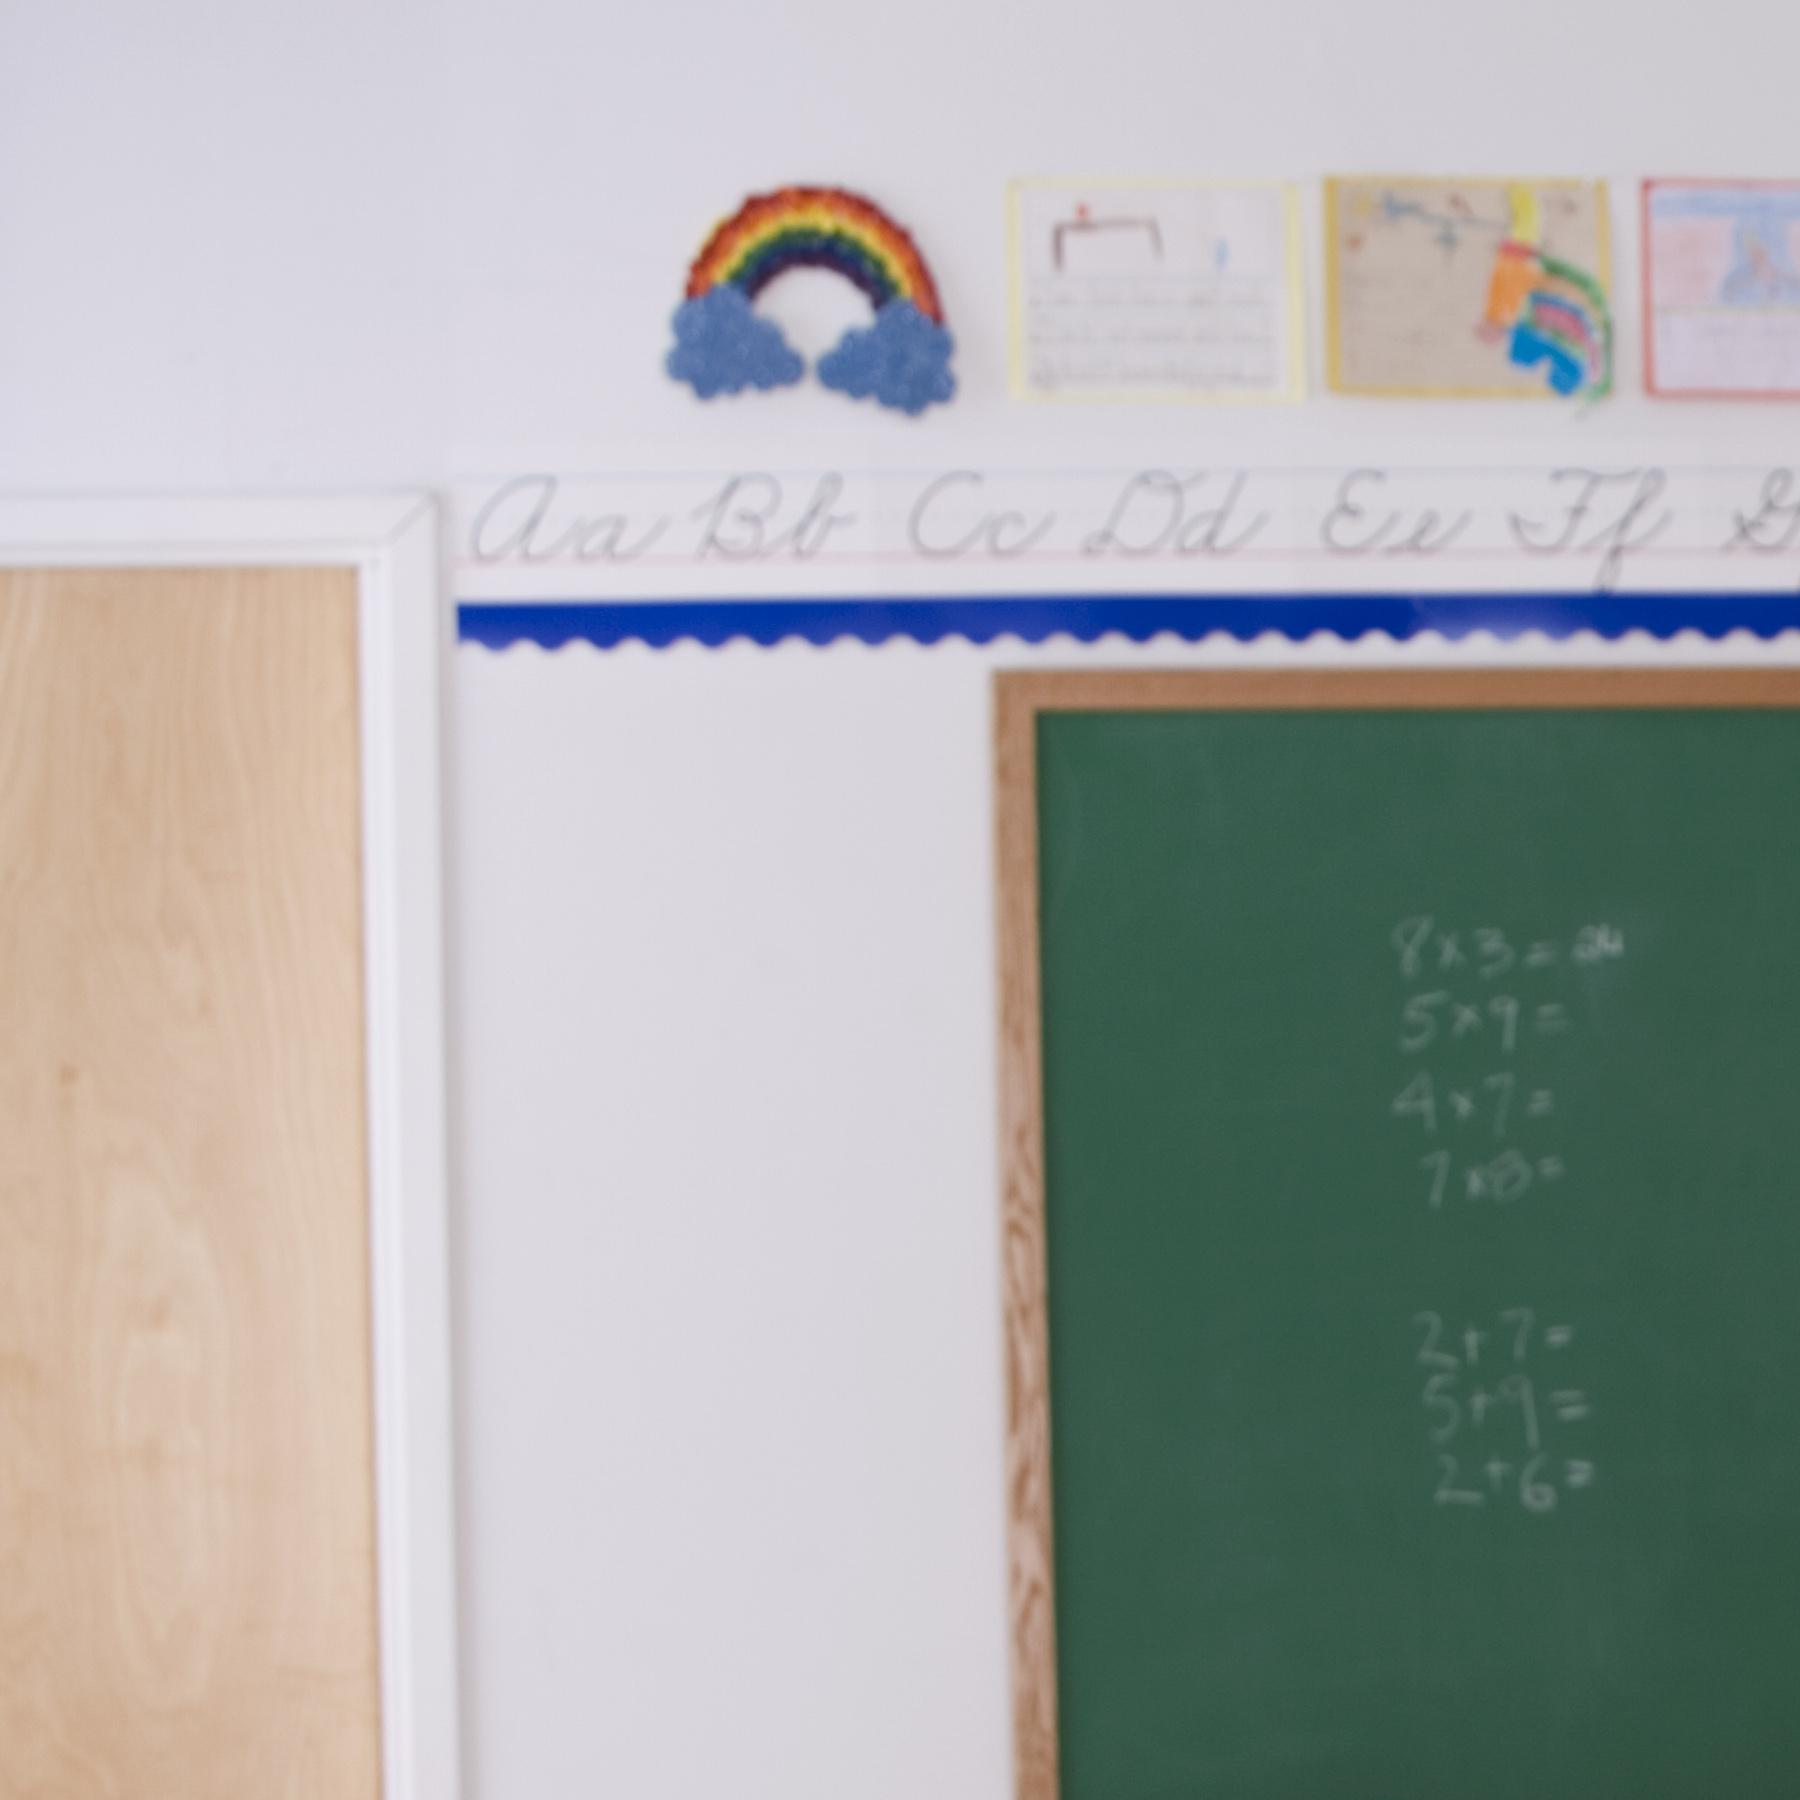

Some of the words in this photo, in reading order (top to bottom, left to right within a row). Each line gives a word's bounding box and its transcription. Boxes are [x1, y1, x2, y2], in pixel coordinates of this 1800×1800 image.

[469, 473, 673, 565] Aa
[688, 471, 855, 565] Bb
[907, 469, 1055, 563] Cc
[1079, 469, 1268, 563] Dd
[1321, 468, 1474, 556] Ee
[1507, 466, 1673, 593] Ff
